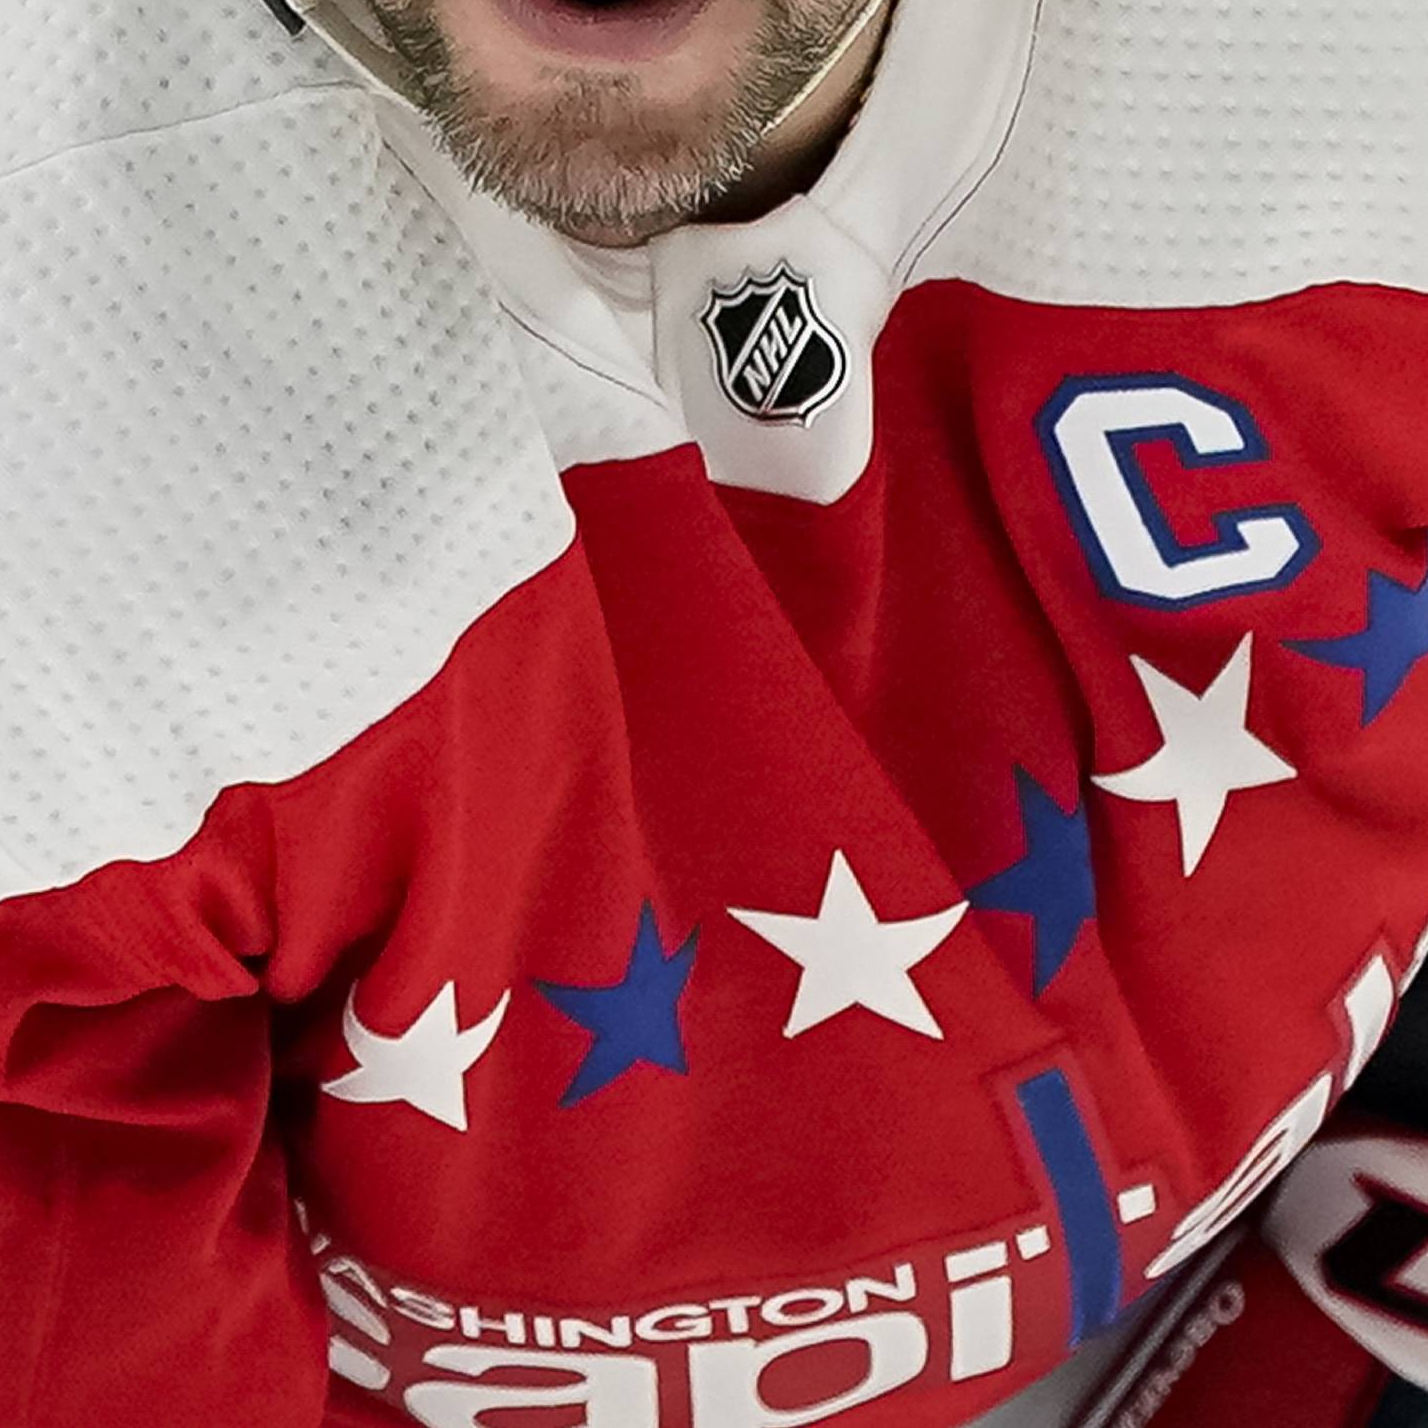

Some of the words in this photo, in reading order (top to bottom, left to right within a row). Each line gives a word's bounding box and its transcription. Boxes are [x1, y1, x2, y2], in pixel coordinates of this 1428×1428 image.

[742, 304, 804, 403] NHL
[1034, 372, 1321, 612] C
[294, 1194, 917, 1349] ASHINGTON
